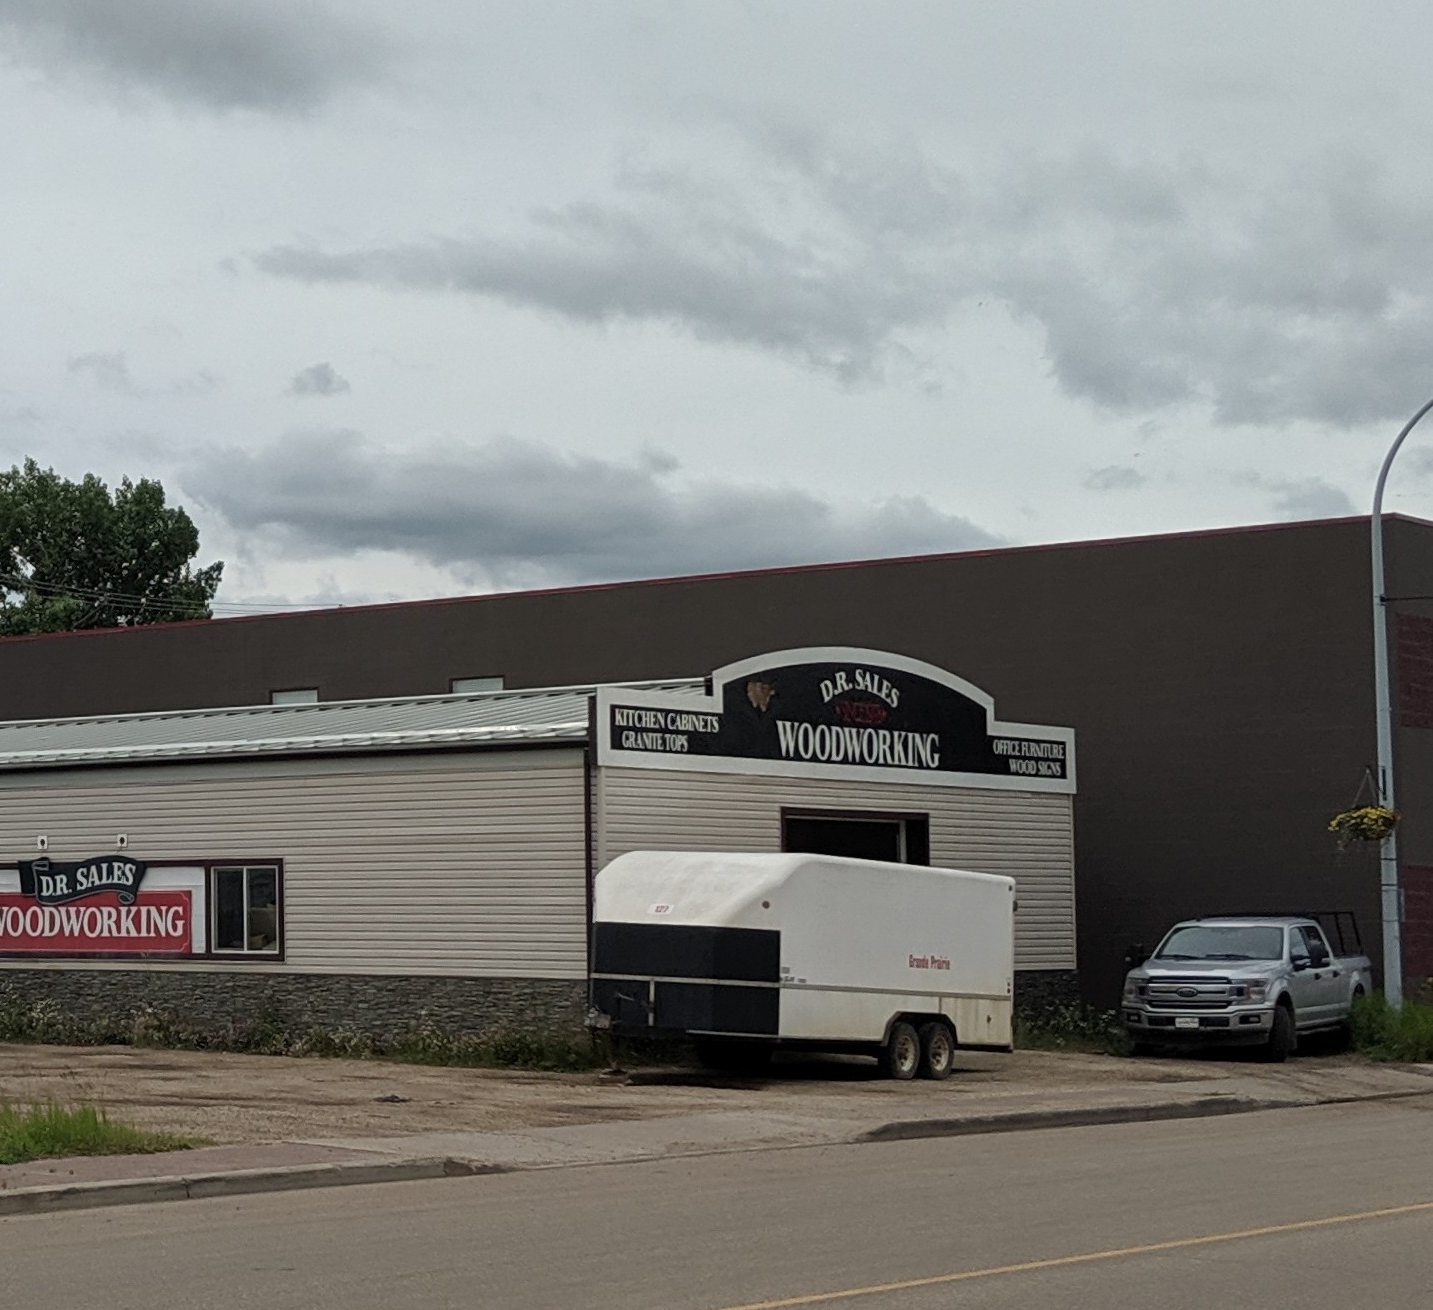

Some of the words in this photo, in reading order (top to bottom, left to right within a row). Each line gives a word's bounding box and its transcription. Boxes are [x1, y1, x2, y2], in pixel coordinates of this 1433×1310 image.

[820, 671, 853, 703] D.R.
[855, 669, 900, 708] SALES
[614, 708, 665, 729] KITCHEN
[667, 712, 720, 733] CABINETS
[621, 730, 664, 750] GRANITE
[664, 733, 688, 752] TOPS
[776, 720, 940, 769] WOODWORKING
[992, 739, 1020, 756] OFFICE
[1021, 741, 1065, 759] FURNITURE
[1008, 758, 1037, 775] WOOD
[1037, 760, 1062, 776] SIGNS
[39, 874, 73, 896] D.R.
[76, 862, 137, 891] SALES
[909, 953, 929, 969] Grande
[931, 955, 951, 970] Prairie
